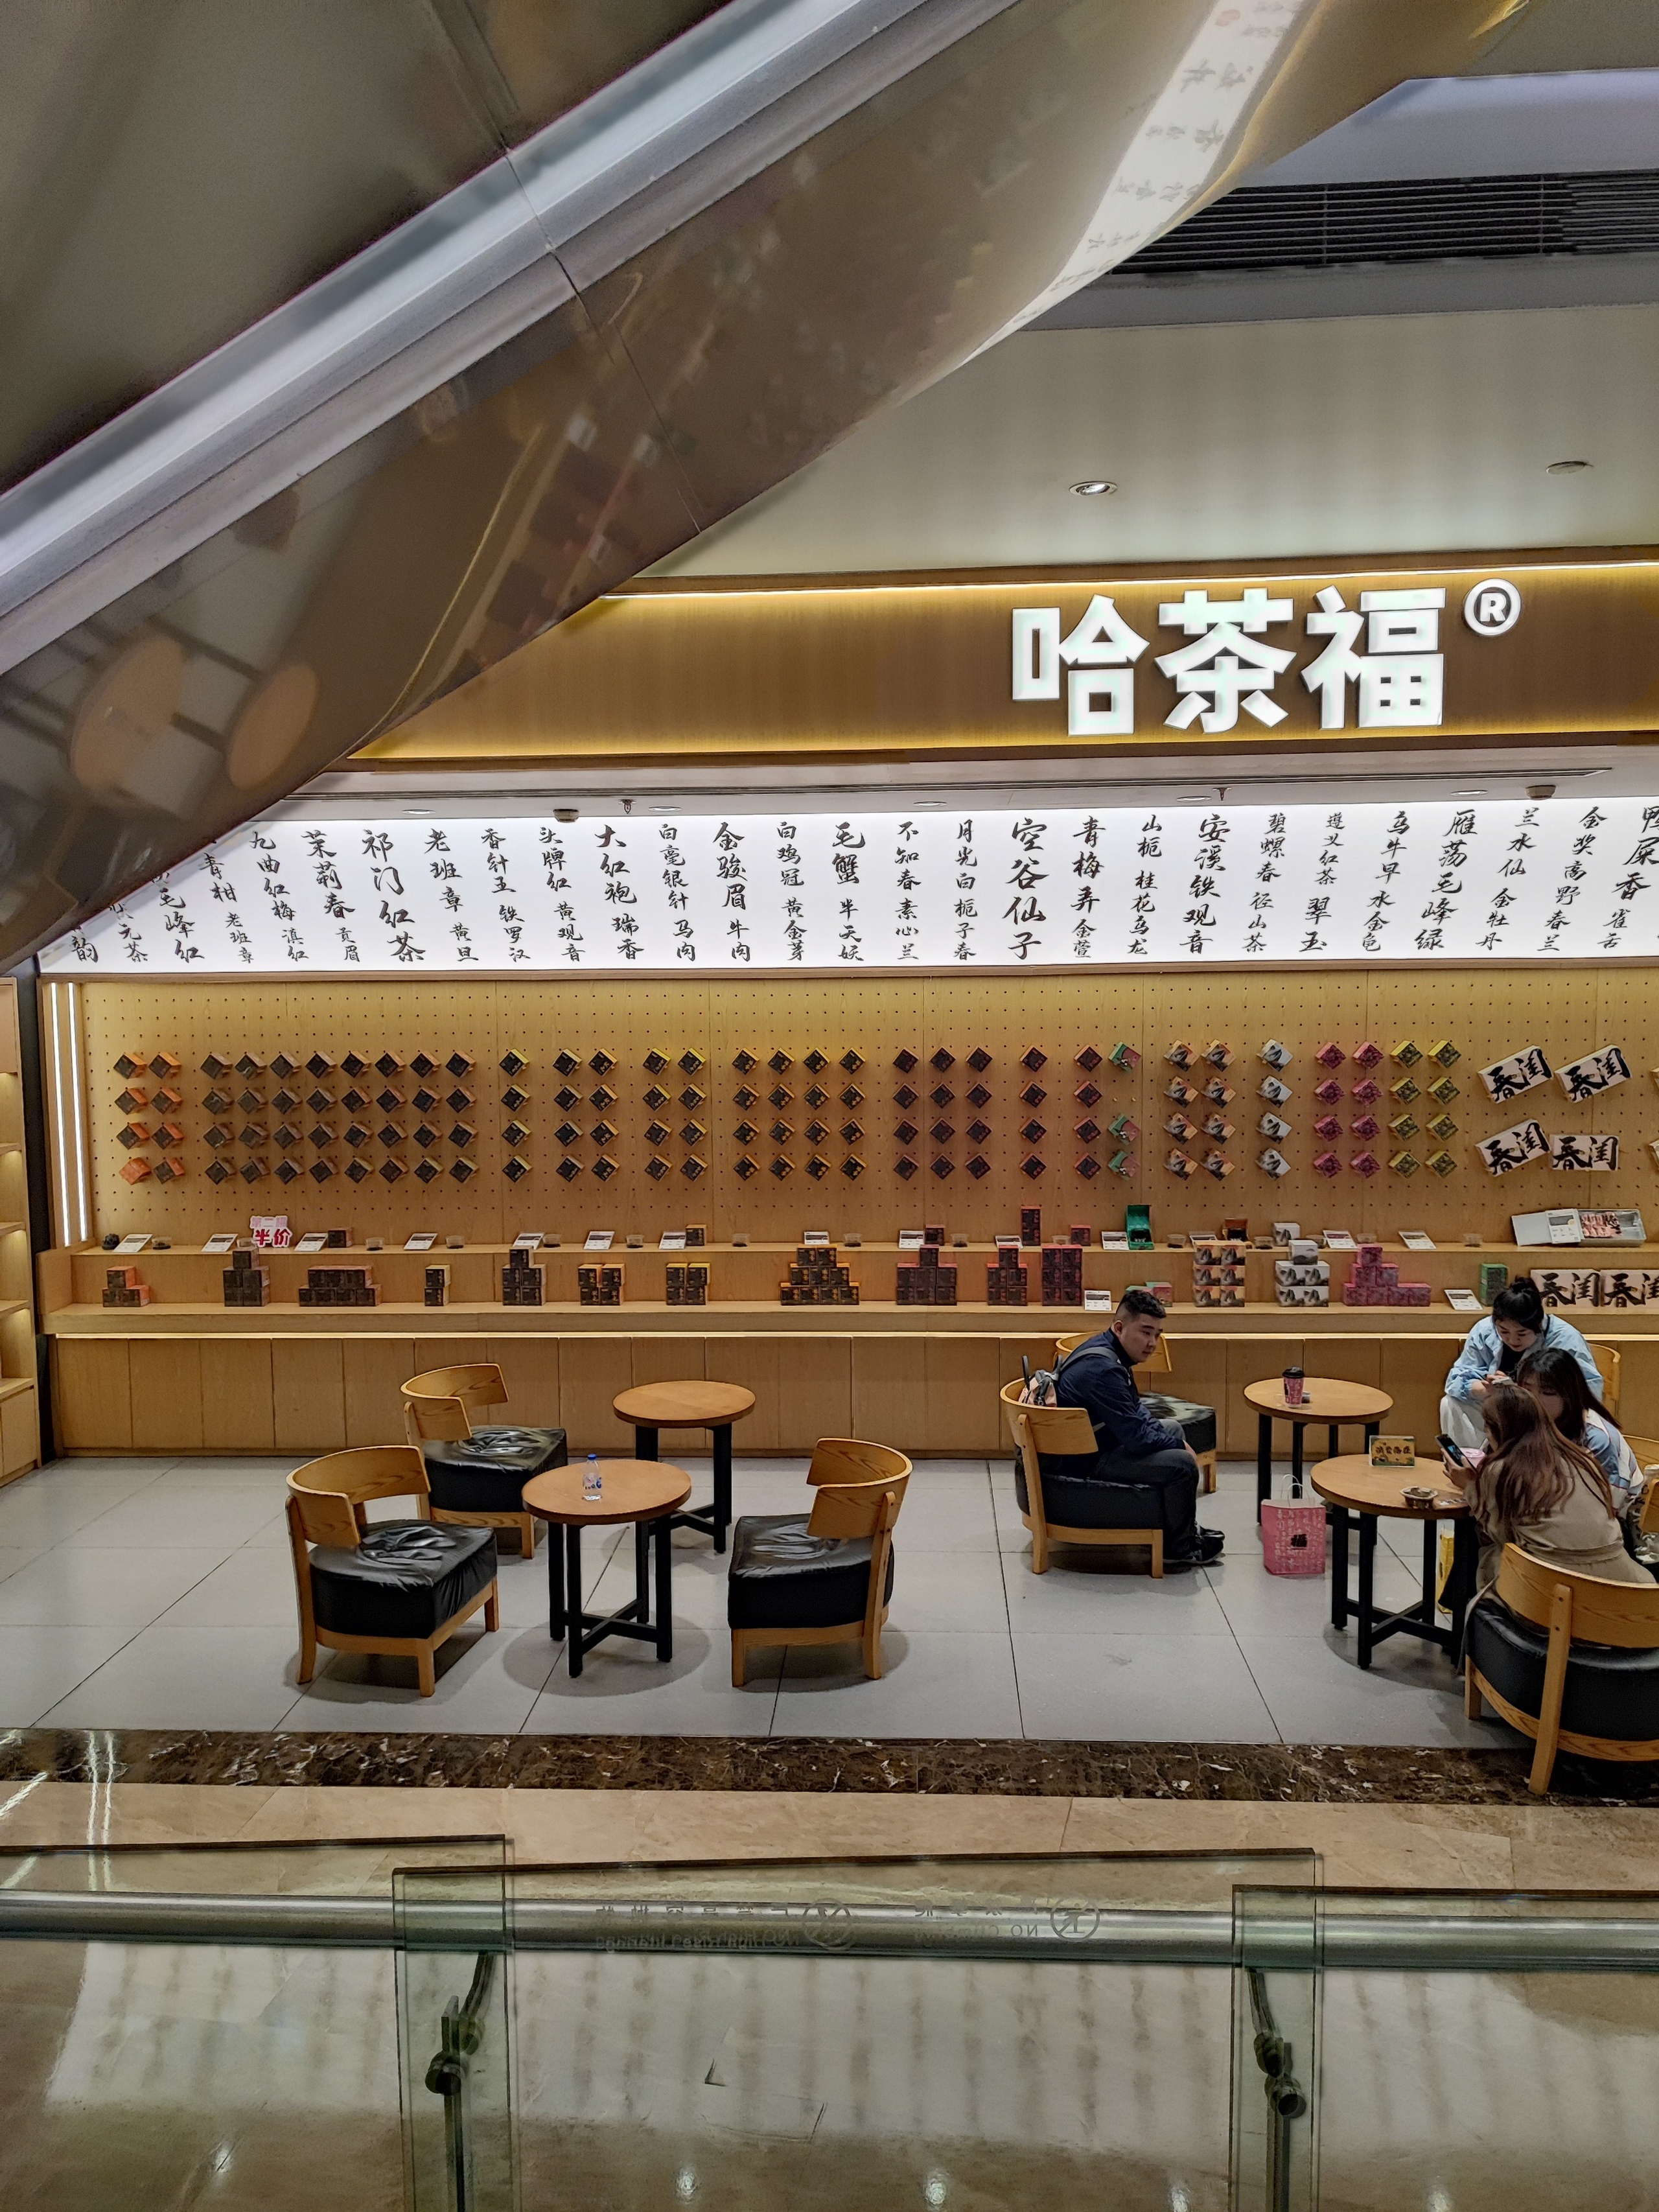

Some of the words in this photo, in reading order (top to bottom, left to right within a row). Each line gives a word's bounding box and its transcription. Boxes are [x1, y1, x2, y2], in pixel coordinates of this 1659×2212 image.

[1012, 585, 1446, 736] 哈茶福
[249, 831, 296, 921] 九曲红梅
[302, 830, 355, 918] 茉莉春
[425, 829, 463, 912] 老班章
[595, 825, 637, 904] 大红袍
[659, 824, 688, 910] 白毫银针
[713, 822, 747, 910] 金骏眉
[777, 822, 804, 886] 白鸡冠
[832, 822, 865, 884] 毛蟹
[895, 822, 921, 890] 不知春
[956, 819, 977, 889] 月光白
[1257, 813, 1286, 882] 碧螺春
[1316, 812, 1345, 885] 遵义红茶
[1376, 811, 1410, 883] 乌牛早
[1415, 809, 1478, 950] 雁荡毛峰绿
[362, 830, 425, 962] 祁门红茶
[1003, 818, 1049, 960] 空谷仙子
[1128, 870, 1157, 954] 桂花乌龙
[1180, 813, 1230, 954] 安溪铁观音
[612, 913, 644, 959] 瑞香
[673, 920, 695, 961] 马肉
[727, 919, 750, 962] 牛肉
[782, 897, 807, 960] 黄金芽
[896, 898, 918, 959] 素心兰
[1299, 897, 1331, 951] 翠玉
[255, 1228, 290, 1246] 半价
